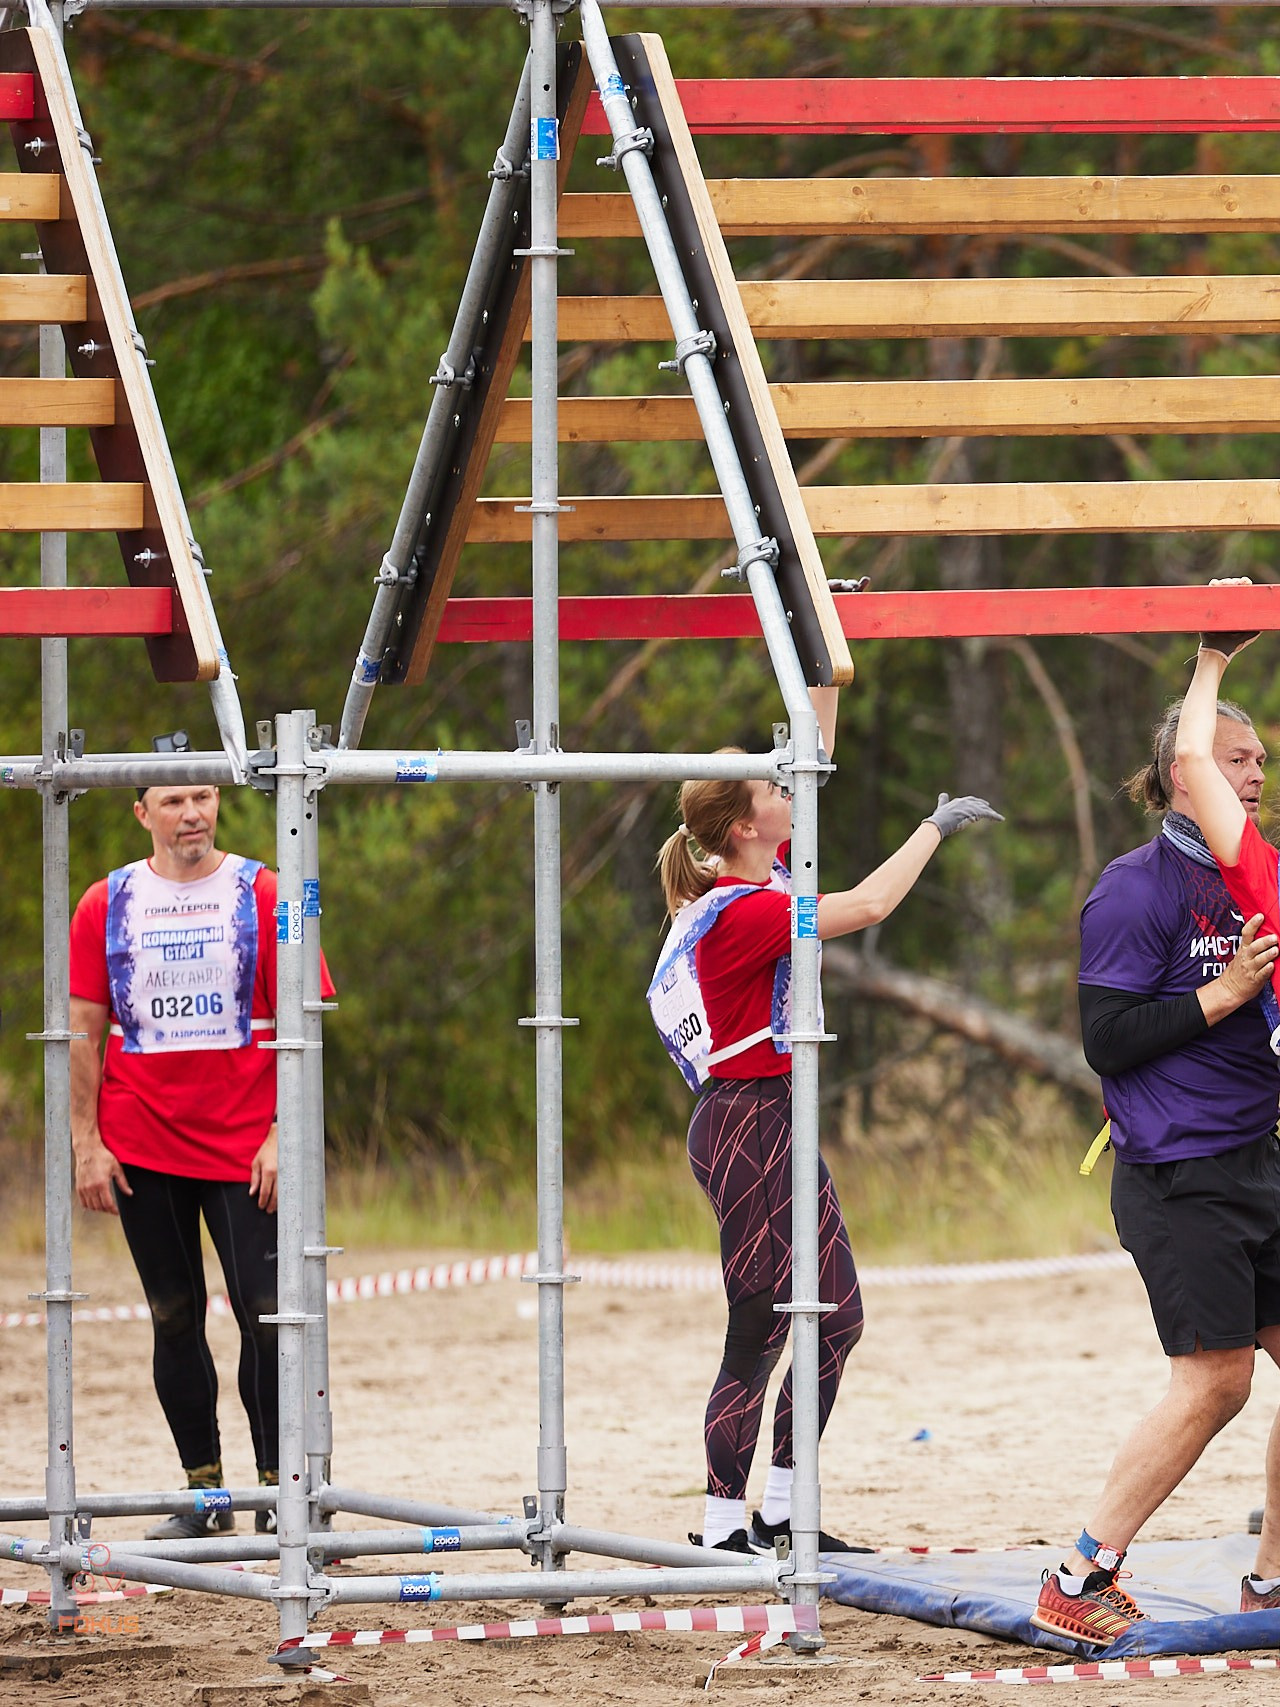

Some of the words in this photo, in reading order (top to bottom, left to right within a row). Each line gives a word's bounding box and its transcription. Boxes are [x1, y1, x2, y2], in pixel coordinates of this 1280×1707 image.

[144, 905, 178, 916] ГОНКА
[181, 903, 220, 913] ГЕРОЕВ
[142, 927, 223, 949] КОМАНДНЫЙ
[165, 943, 203, 960] СТАРТ
[1190, 935, 1242, 957] ИНСТ
[151, 992, 224, 1019] 03206
[171, 1028, 227, 1038] ГАЗПРОМБАНК
[433, 1536, 460, 1546] СОЮЗ
[402, 1584, 431, 1594] СОЮЗ
